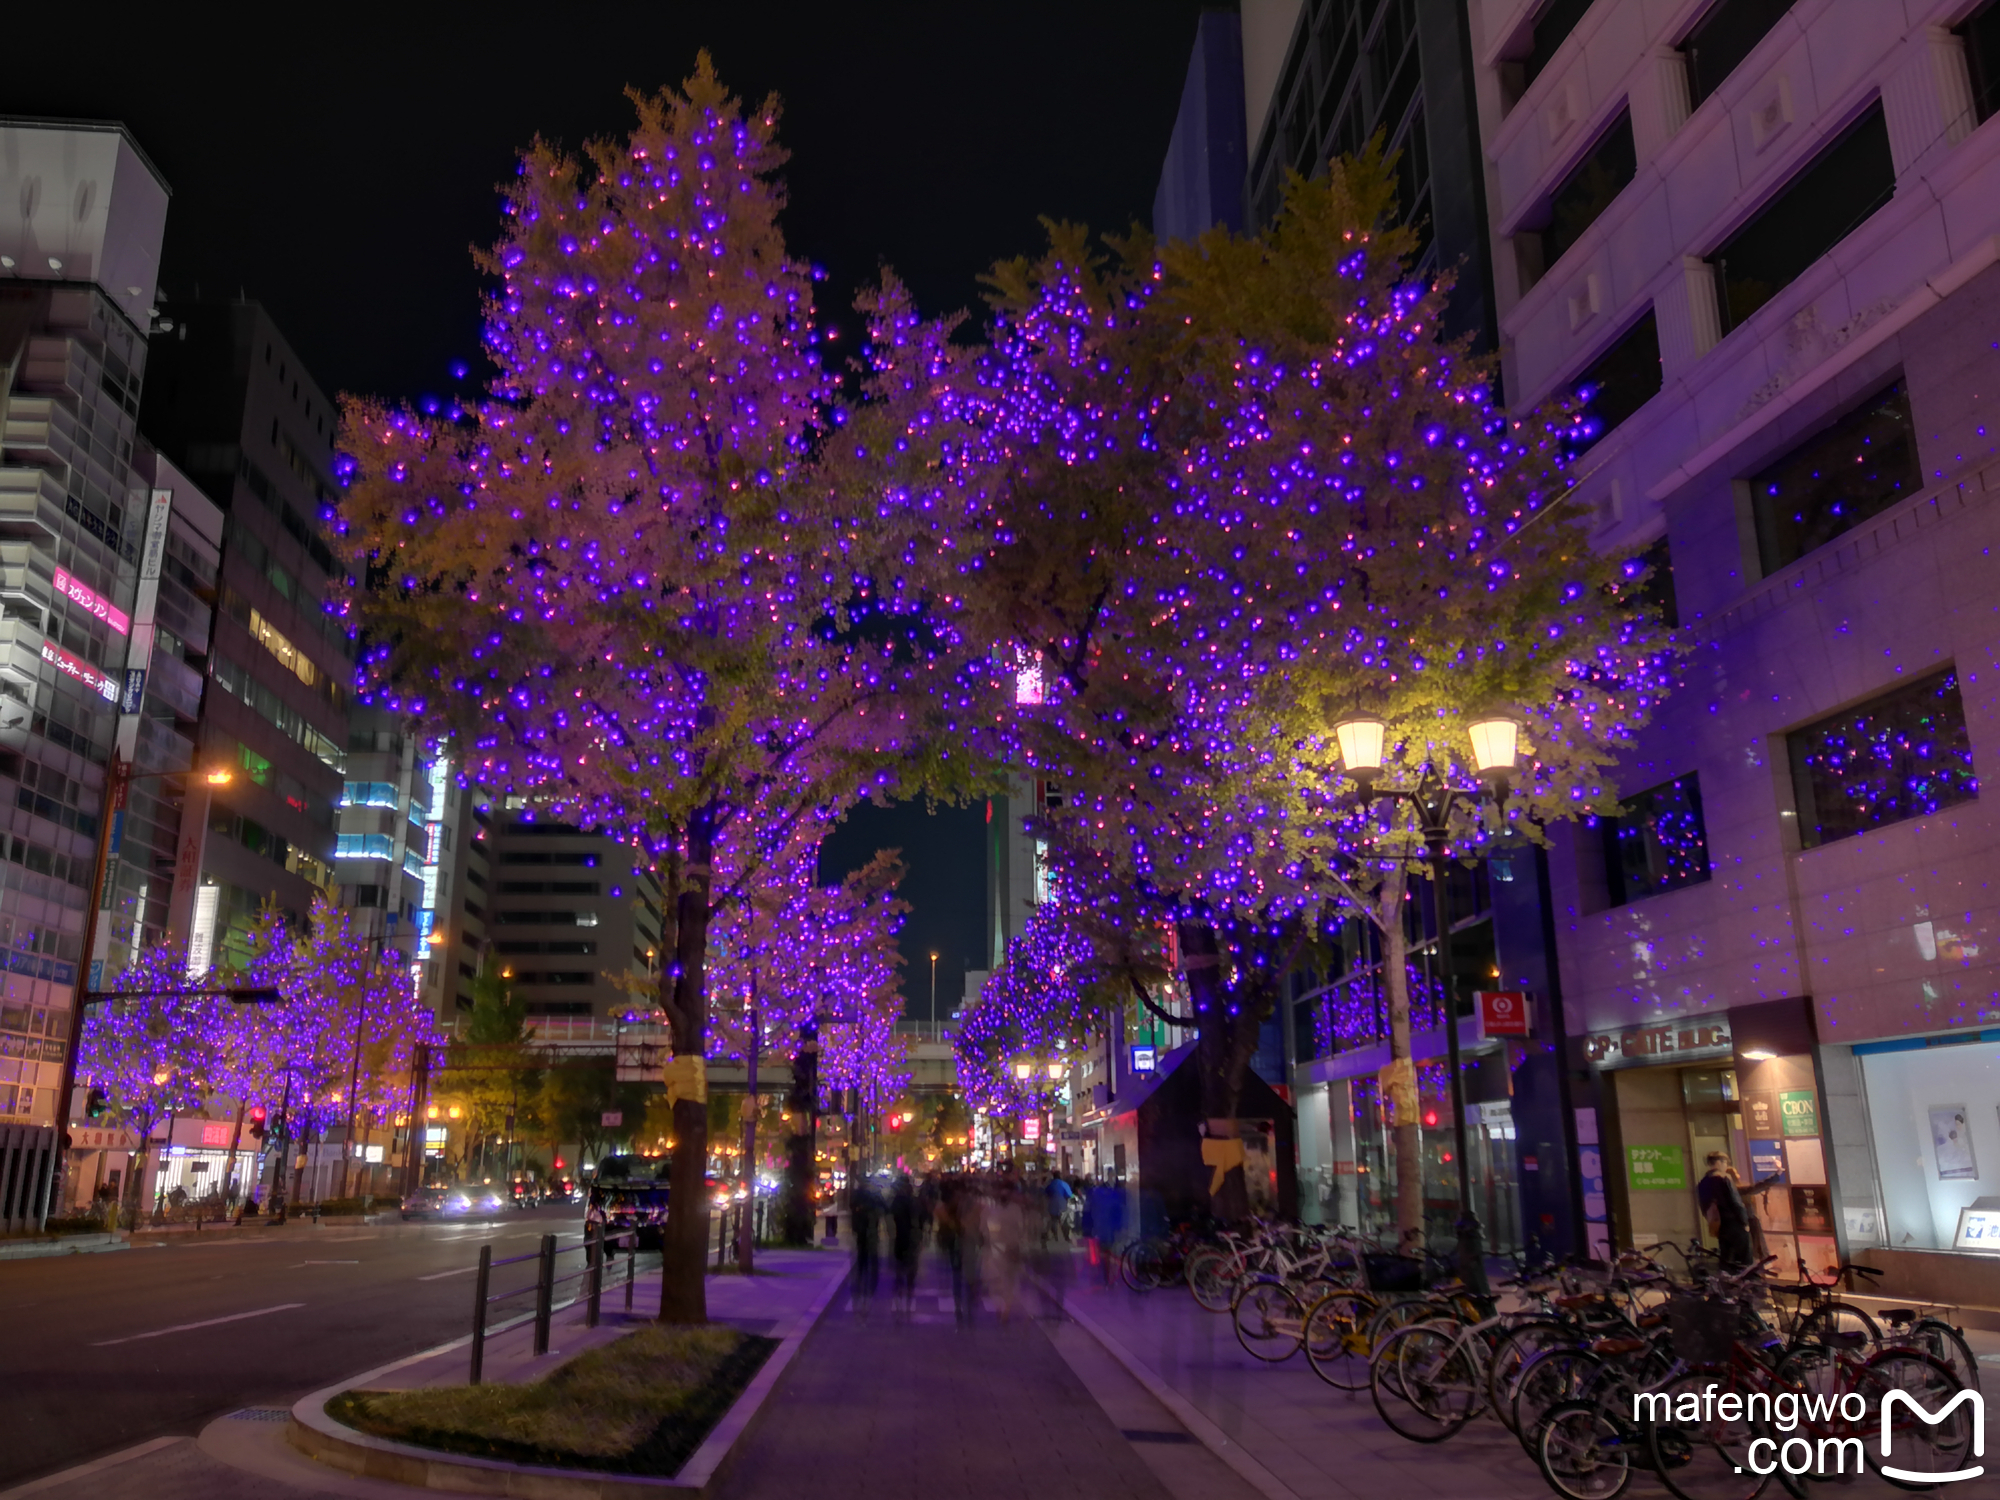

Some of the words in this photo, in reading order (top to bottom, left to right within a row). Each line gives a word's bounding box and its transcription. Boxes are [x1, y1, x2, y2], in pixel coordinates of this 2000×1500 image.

[1783, 1100, 1814, 1115] CBON
[1631, 1149, 1662, 1160] テナント
